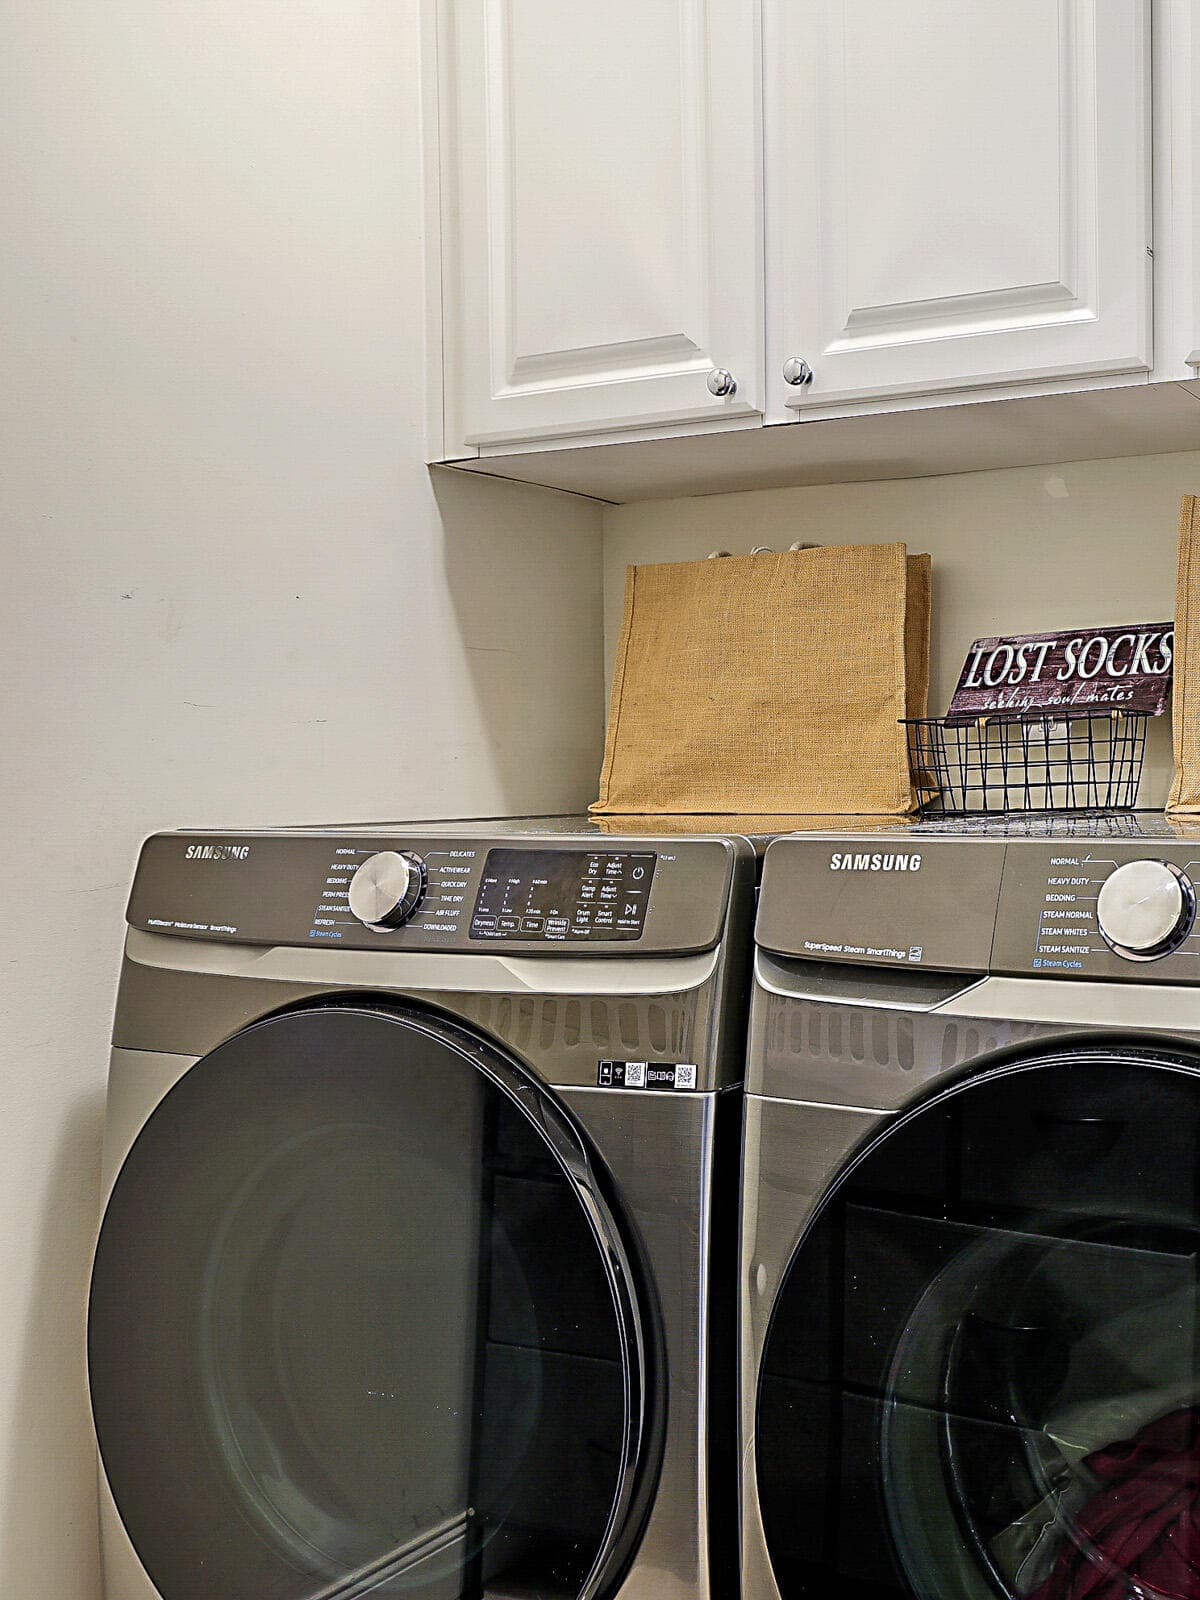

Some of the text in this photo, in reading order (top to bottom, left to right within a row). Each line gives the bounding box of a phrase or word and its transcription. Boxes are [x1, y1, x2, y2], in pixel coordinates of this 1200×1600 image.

[962, 631, 1174, 688] LOST SOCKS
[982, 682, 1134, 713] seeking soul mates
[185, 845, 250, 860] SAMSUNG
[830, 853, 921, 871] SAMSUNG
[1050, 857, 1080, 865] NORMAL
[1047, 877, 1090, 886] HEAVY DUTY
[1045, 894, 1076, 902] BEDDING
[1043, 911, 1066, 919] STEAM
[474, 920, 494, 928] Dryness
[1040, 928, 1088, 936] STEAM WHITES
[804, 941, 842, 953] SuperSpeed
[843, 945, 865, 954] Steam
[866, 947, 906, 959] SmartThings
[1038, 945, 1090, 954] STEAM SANITIZE
[1042, 959, 1082, 969] Steam Cycles
